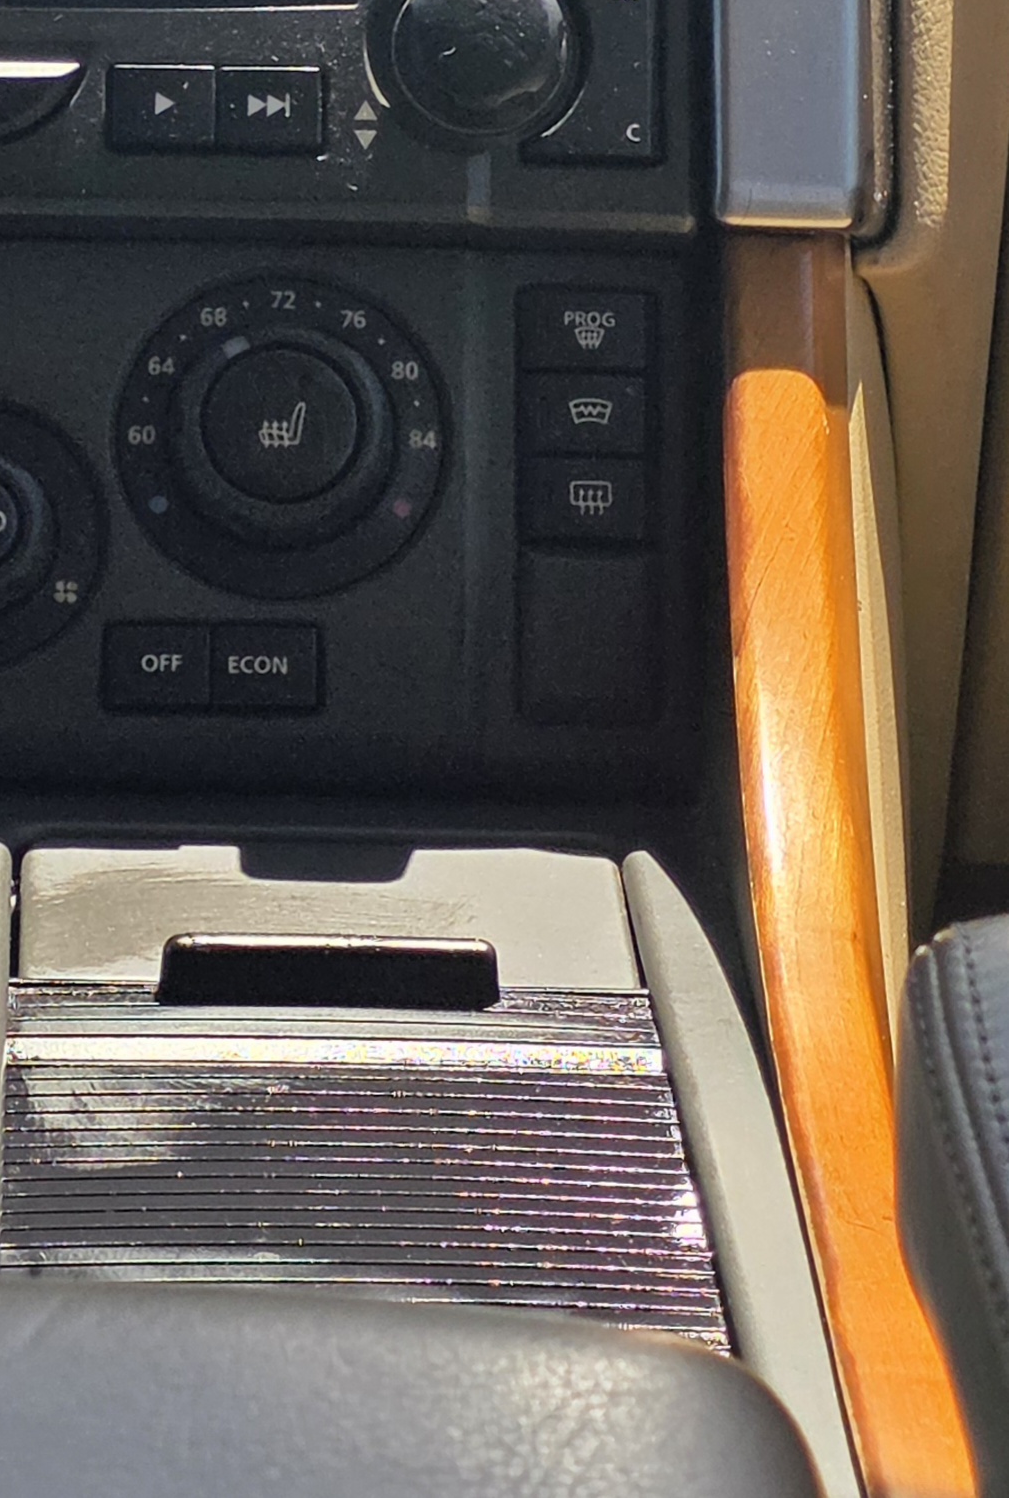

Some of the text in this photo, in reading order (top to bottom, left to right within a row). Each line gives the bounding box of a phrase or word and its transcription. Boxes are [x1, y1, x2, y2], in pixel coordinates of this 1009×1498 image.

[626, 126, 642, 143] C
[270, 291, 297, 310] 72
[200, 309, 228, 328] 68
[341, 311, 367, 329] 76
[564, 311, 616, 327] PROG
[148, 358, 176, 376] 64
[392, 361, 419, 380] 80
[128, 427, 155, 444] 60
[410, 431, 437, 449] 84
[140, 655, 184, 674] OFF
[227, 656, 289, 674] ECON
